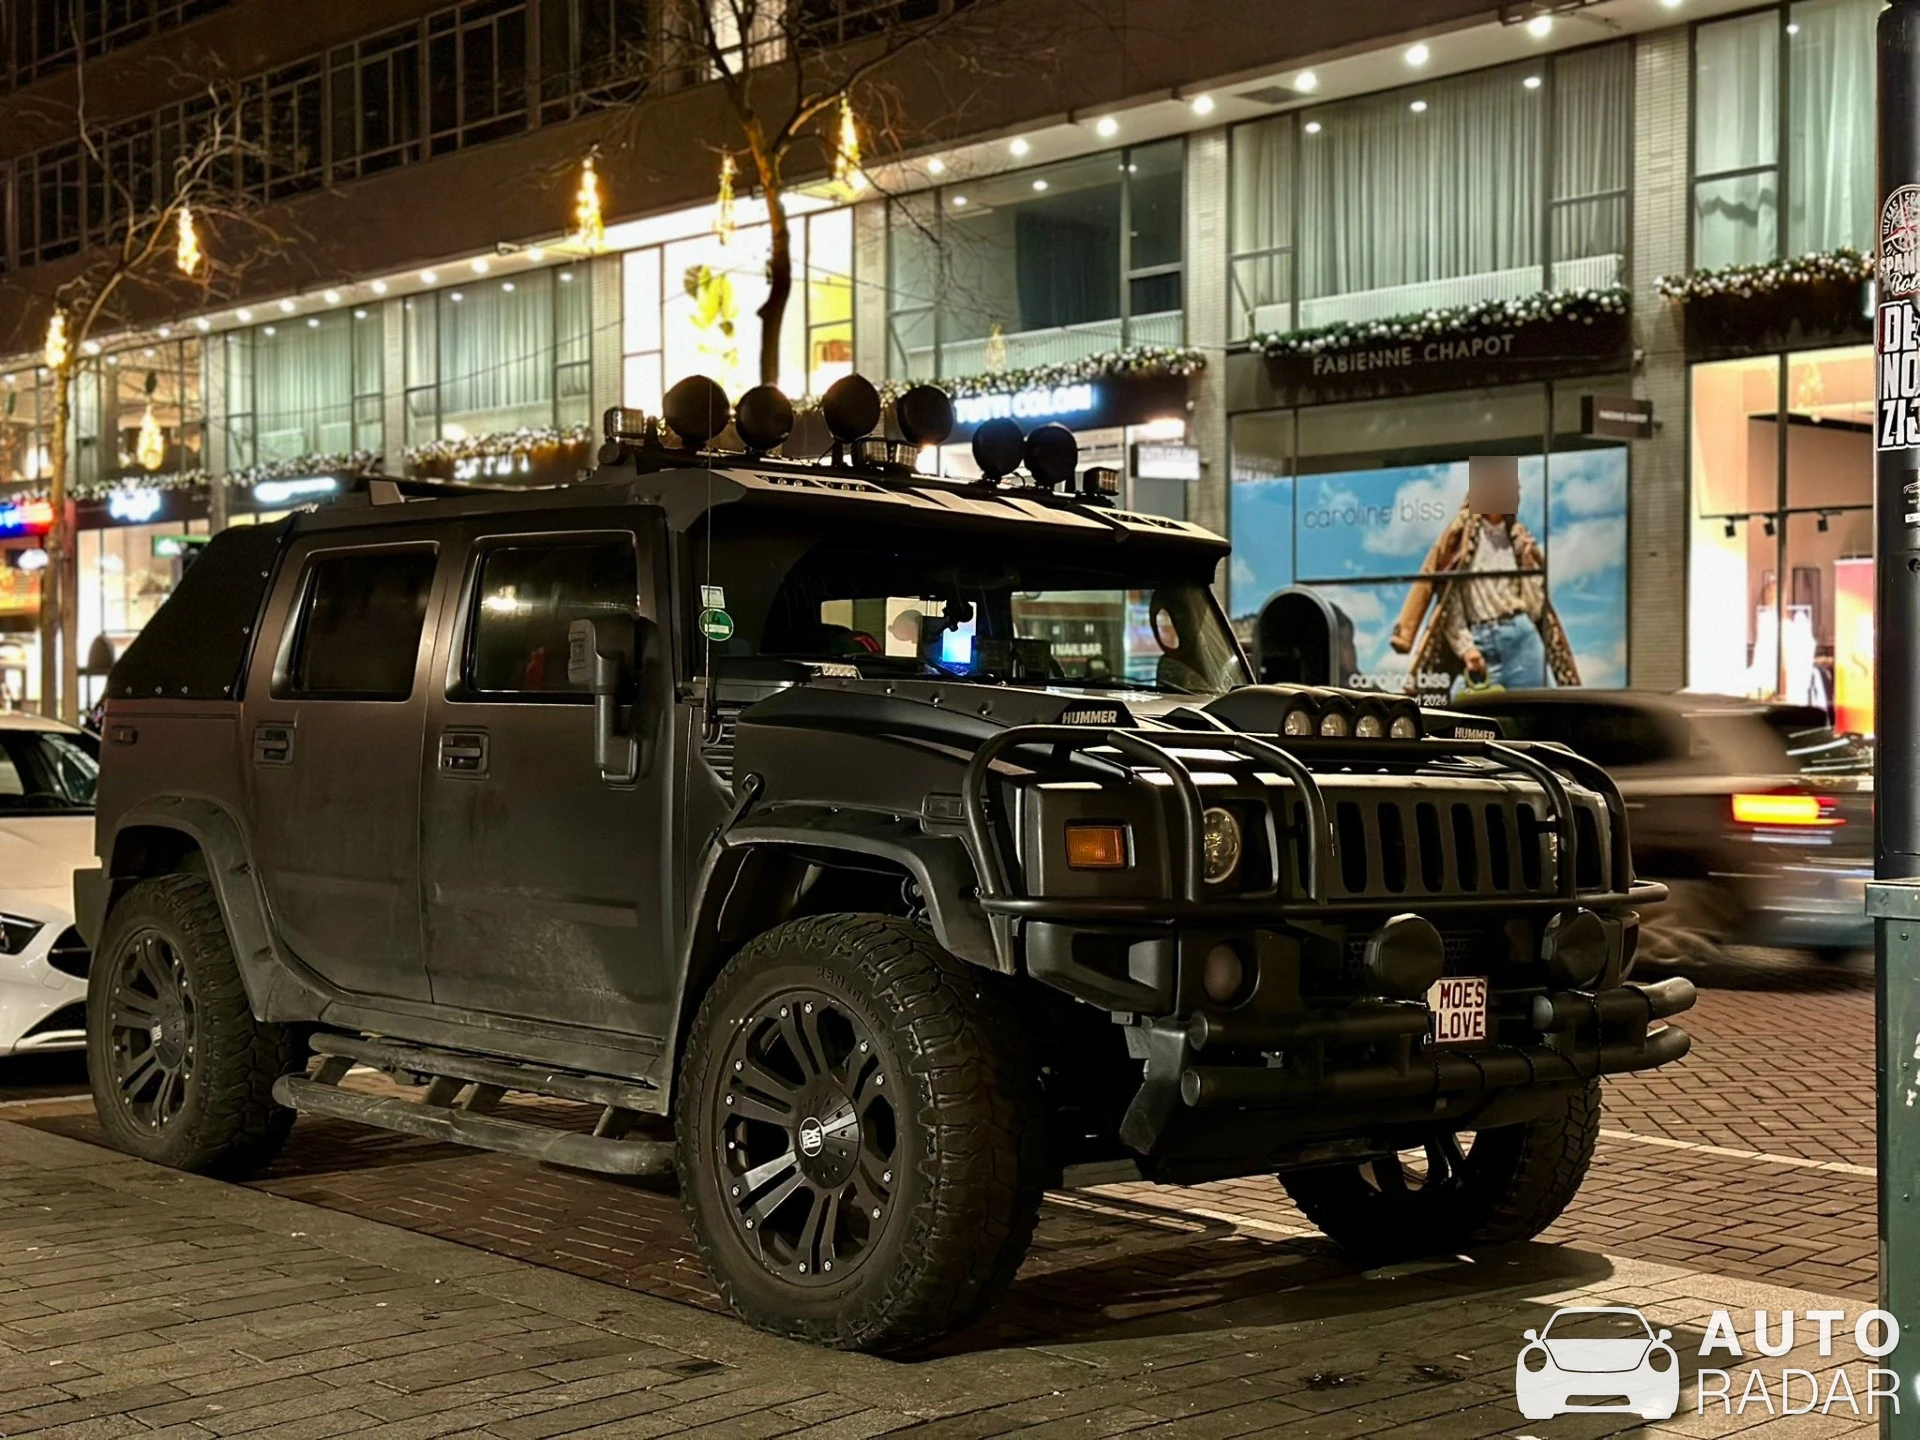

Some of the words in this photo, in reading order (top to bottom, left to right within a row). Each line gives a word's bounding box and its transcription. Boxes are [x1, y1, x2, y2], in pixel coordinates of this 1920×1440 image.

[1882, 200, 1899, 235] ULTRAS
[1313, 347, 1413, 376] FABIENNE
[1424, 334, 1515, 362] CHAPOT
[1304, 501, 1393, 529] caroline
[1423, 694, 1448, 707] 2026
[1061, 710, 1118, 724] HUMMER
[1454, 727, 1496, 740] HUMMER
[1439, 982, 1486, 1009] MOES
[1438, 1011, 1484, 1039] LOVE
